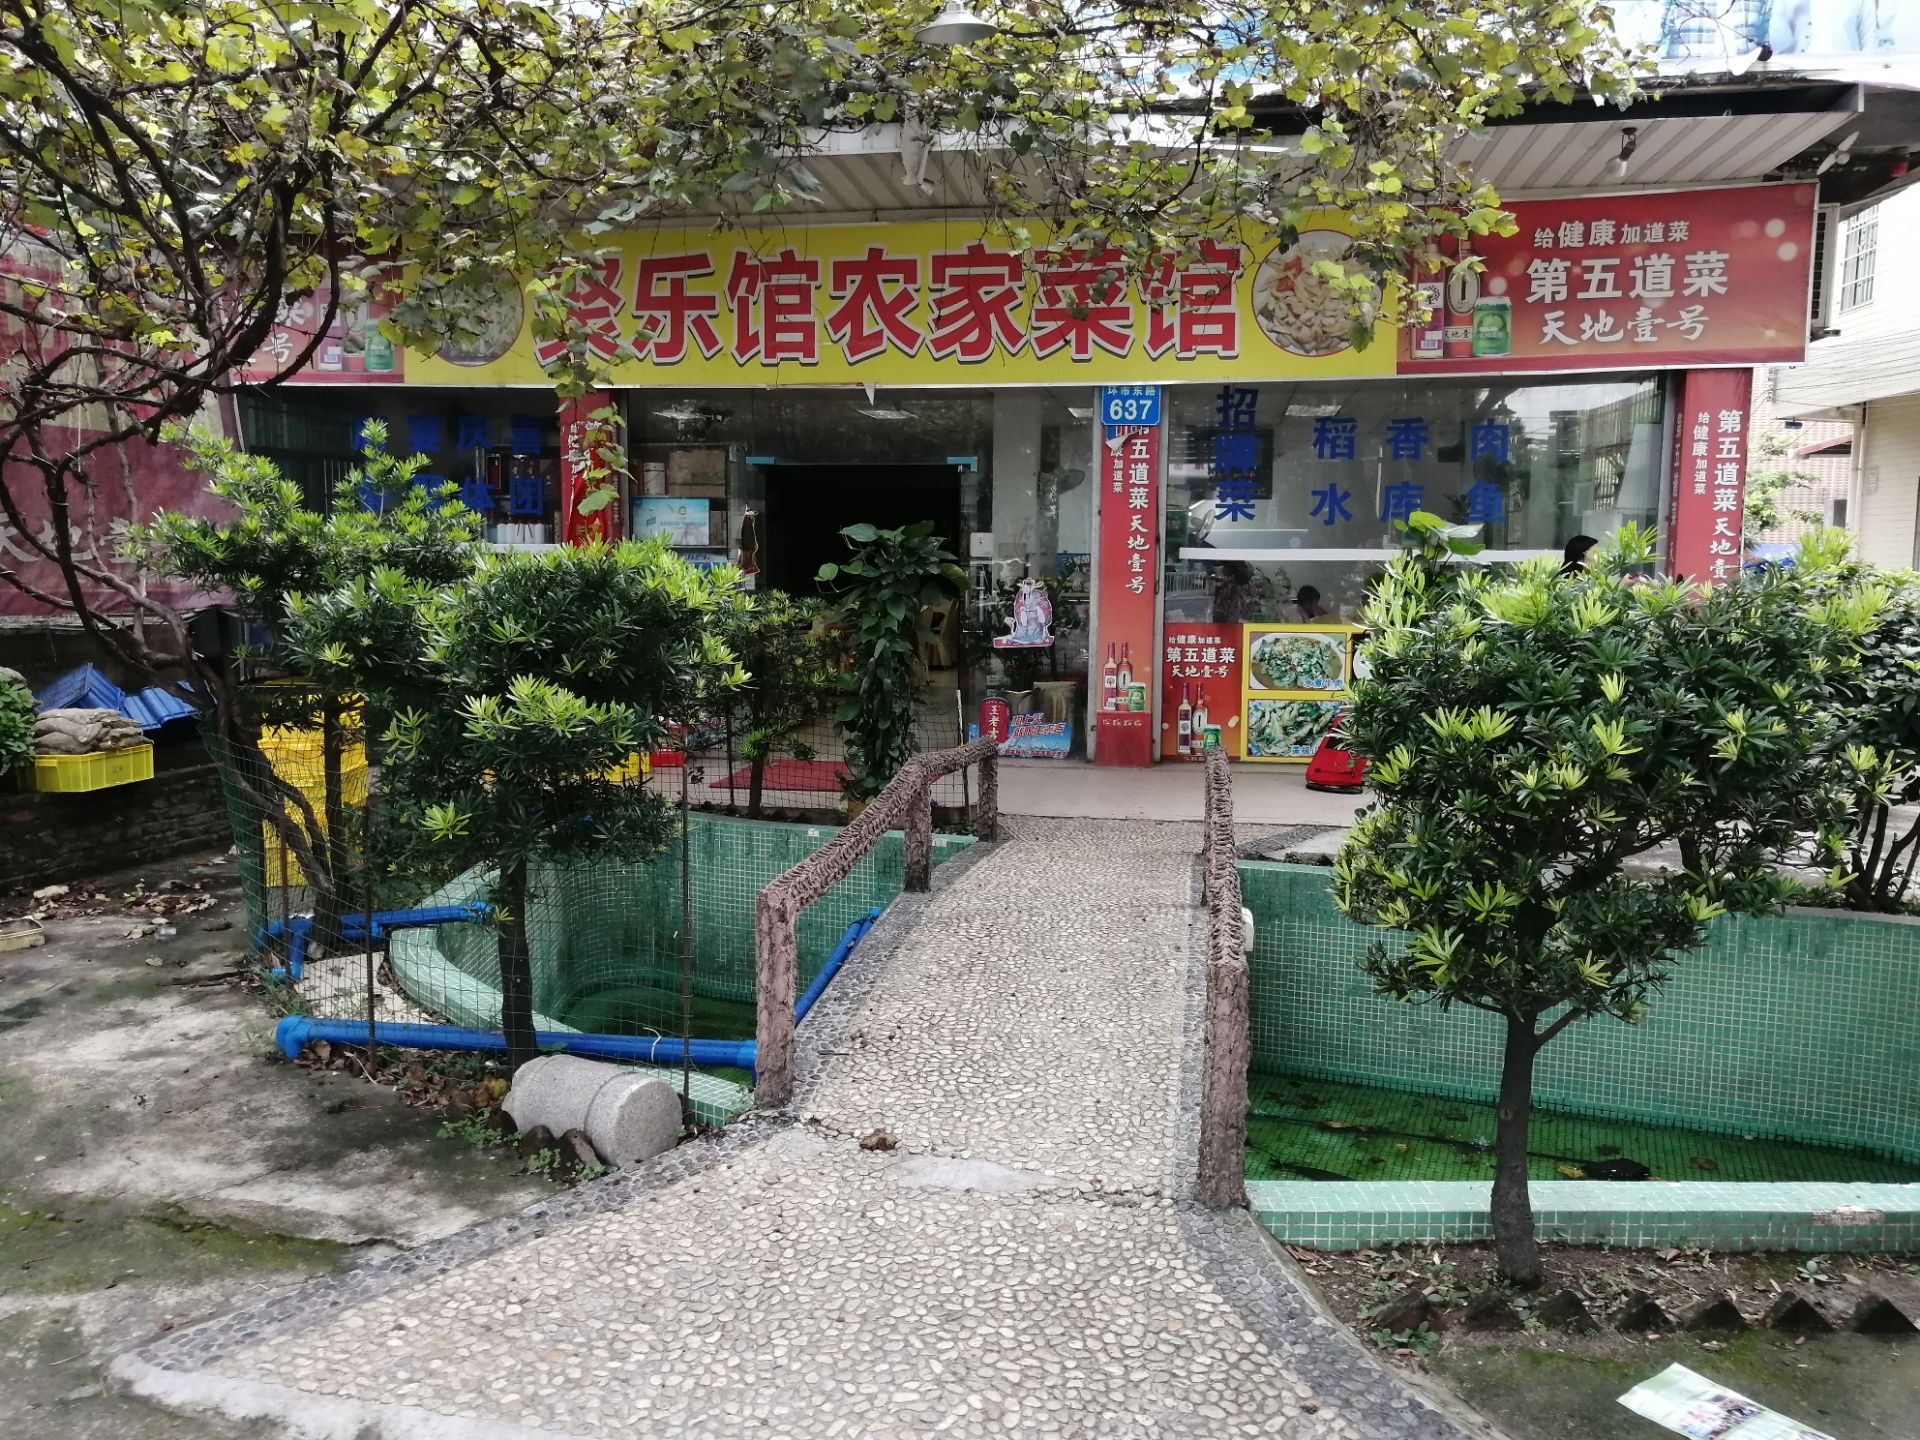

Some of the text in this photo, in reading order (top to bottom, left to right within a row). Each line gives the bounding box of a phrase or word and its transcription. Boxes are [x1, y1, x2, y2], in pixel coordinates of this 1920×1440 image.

[1533, 219, 1690, 249] 给健康加道菜
[1525, 251, 1730, 304] 第五道菜
[1539, 304, 1710, 346] 天地壹号
[1107, 386, 1156, 396] 环市东路
[1109, 399, 1152, 420] 637
[1692, 411, 1711, 496] 给健康加道菜
[1168, 634, 1222, 645] 给健康加道菜
[1166, 646, 1236, 663] 第五道菜
[1171, 665, 1229, 678] 天地壹号
